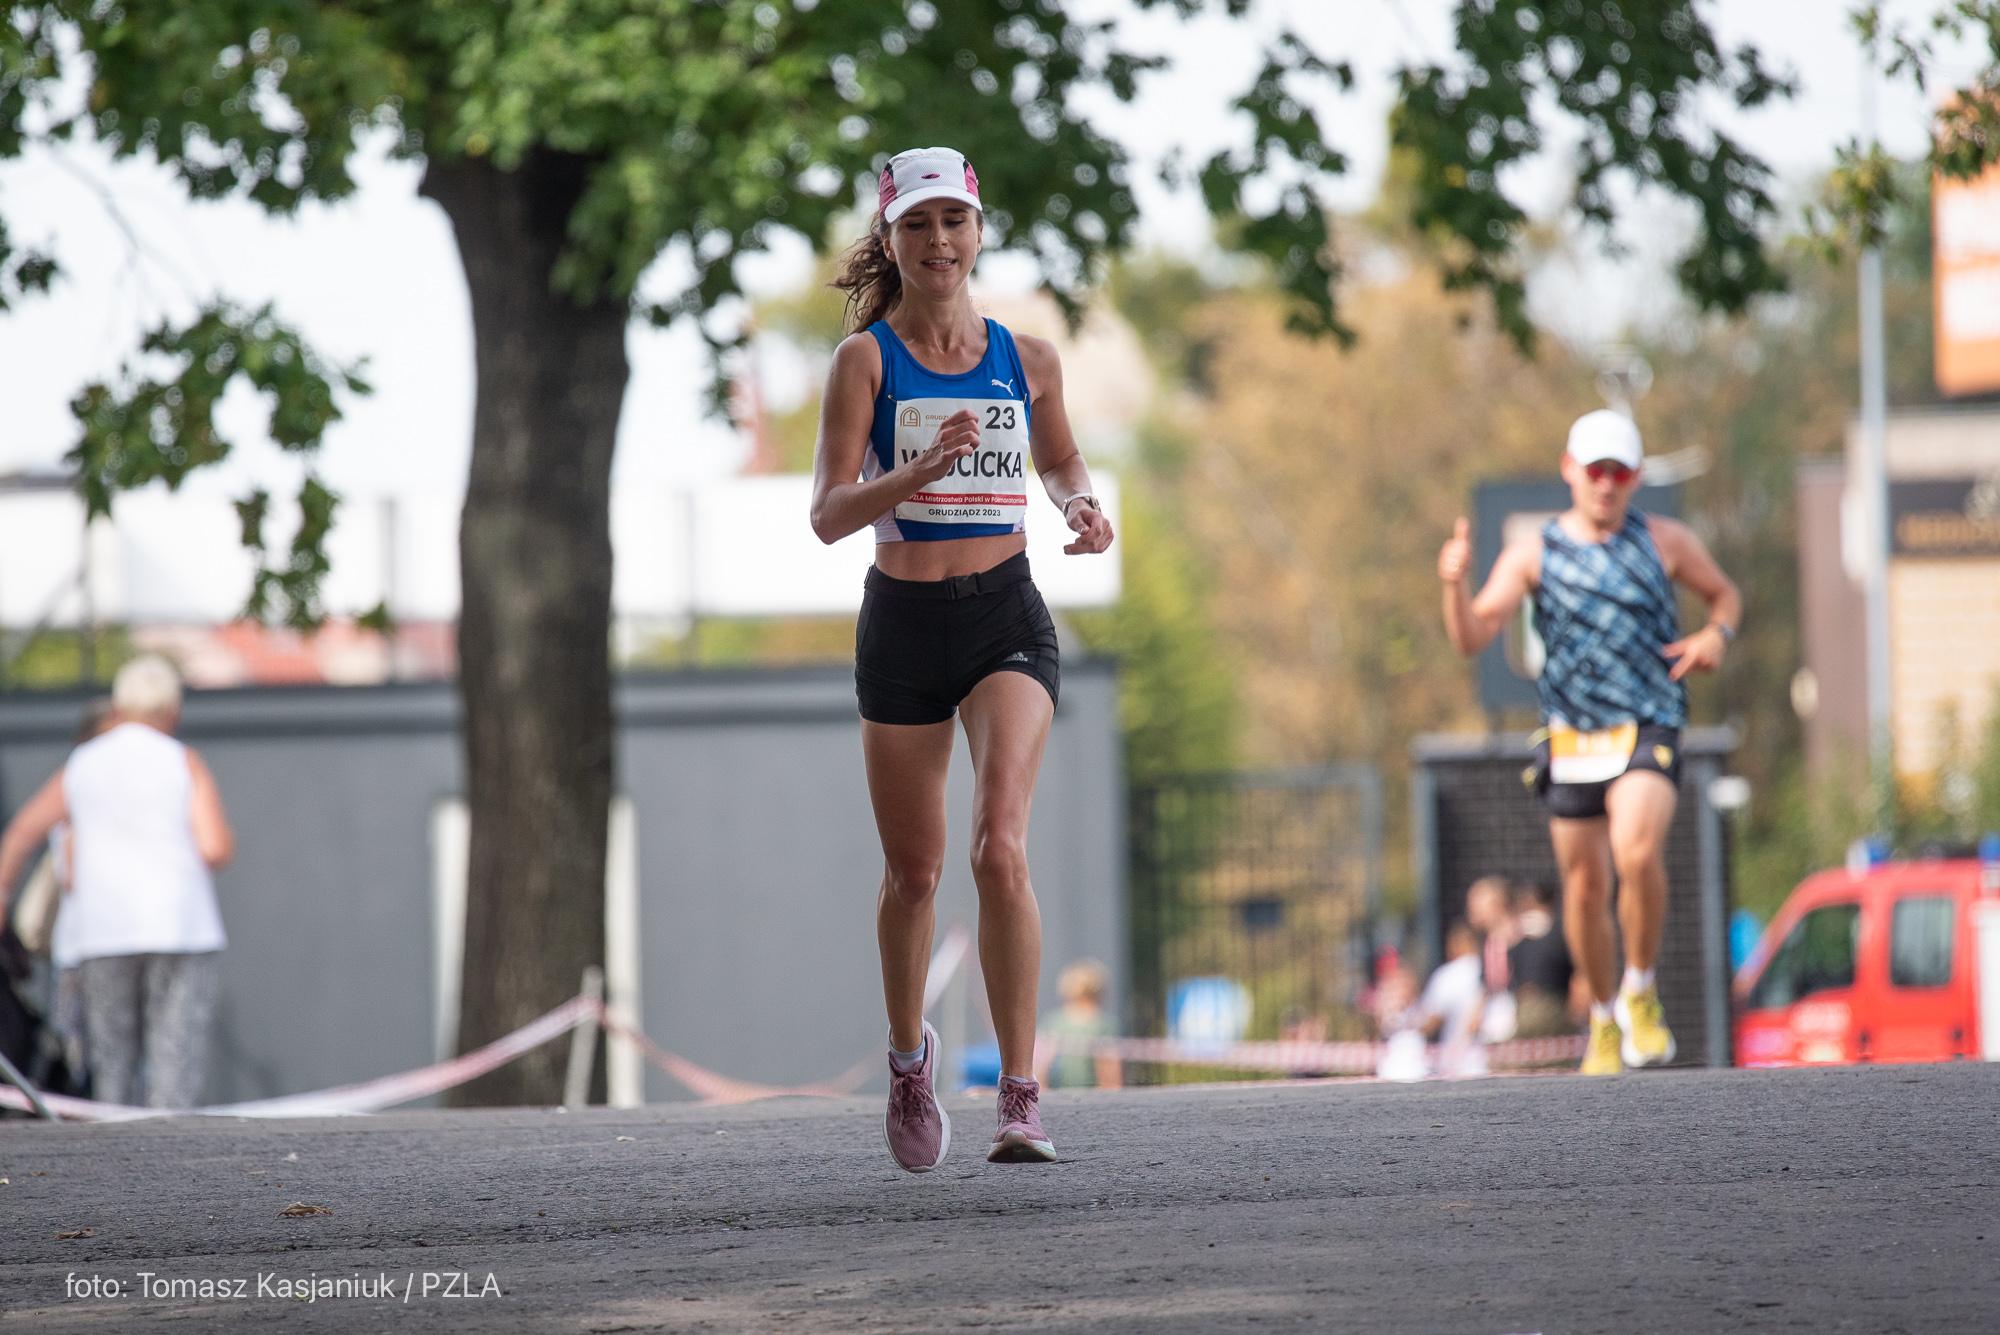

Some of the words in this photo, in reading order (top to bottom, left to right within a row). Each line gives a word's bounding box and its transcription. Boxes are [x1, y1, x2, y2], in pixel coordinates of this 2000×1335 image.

[985, 406, 1016, 429] 23
[925, 495, 963, 503] Mistrzostwa
[928, 508, 981, 518] GRUDZIĄDZ
[982, 508, 1001, 517] 2023
